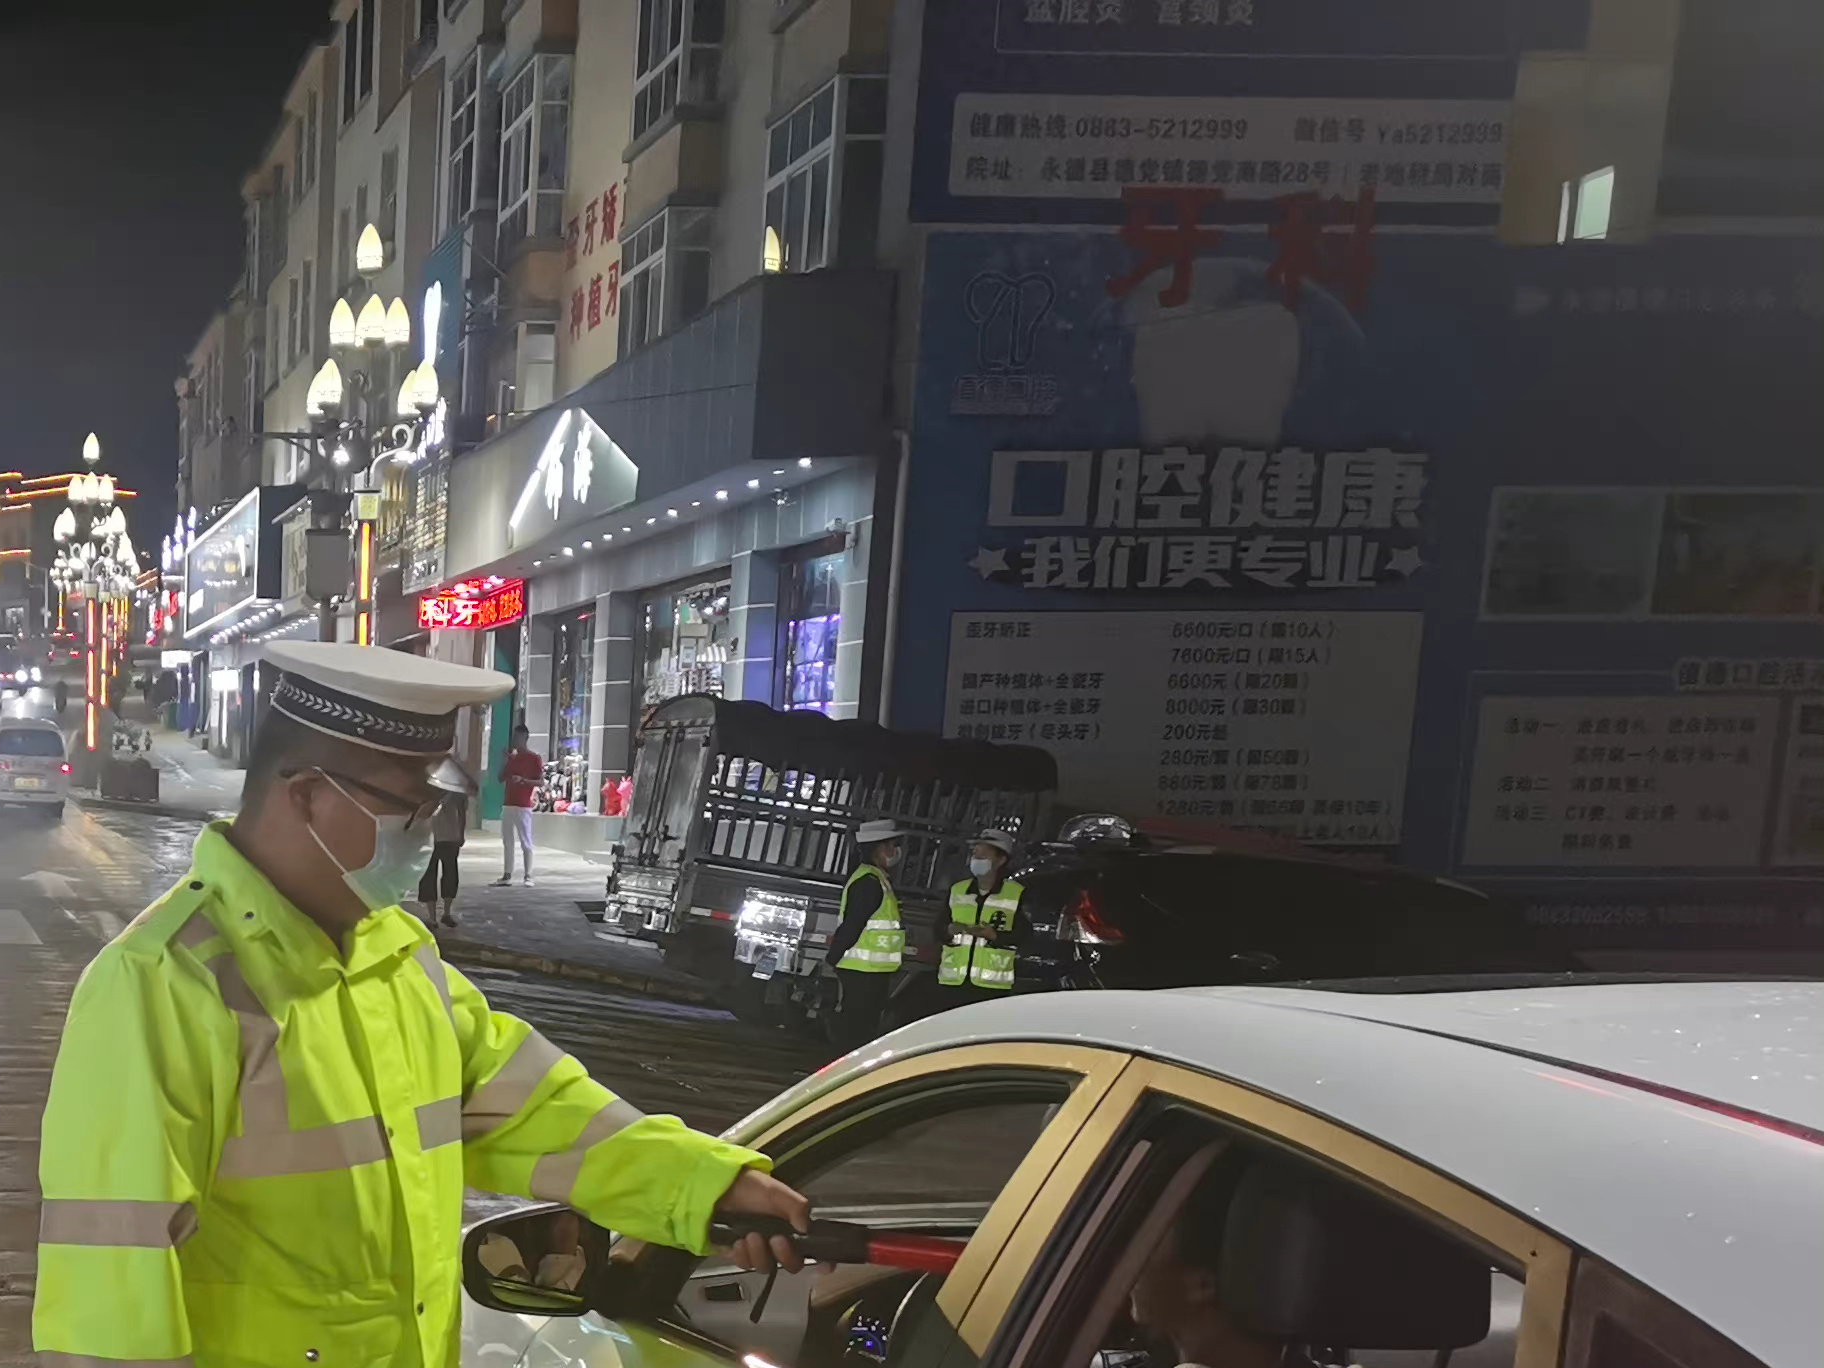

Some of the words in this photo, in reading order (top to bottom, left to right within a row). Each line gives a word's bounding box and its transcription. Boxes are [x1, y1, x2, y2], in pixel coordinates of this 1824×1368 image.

[987, 447, 1430, 530] 口腔健康
[1020, 535, 1380, 590] 我们更专业
